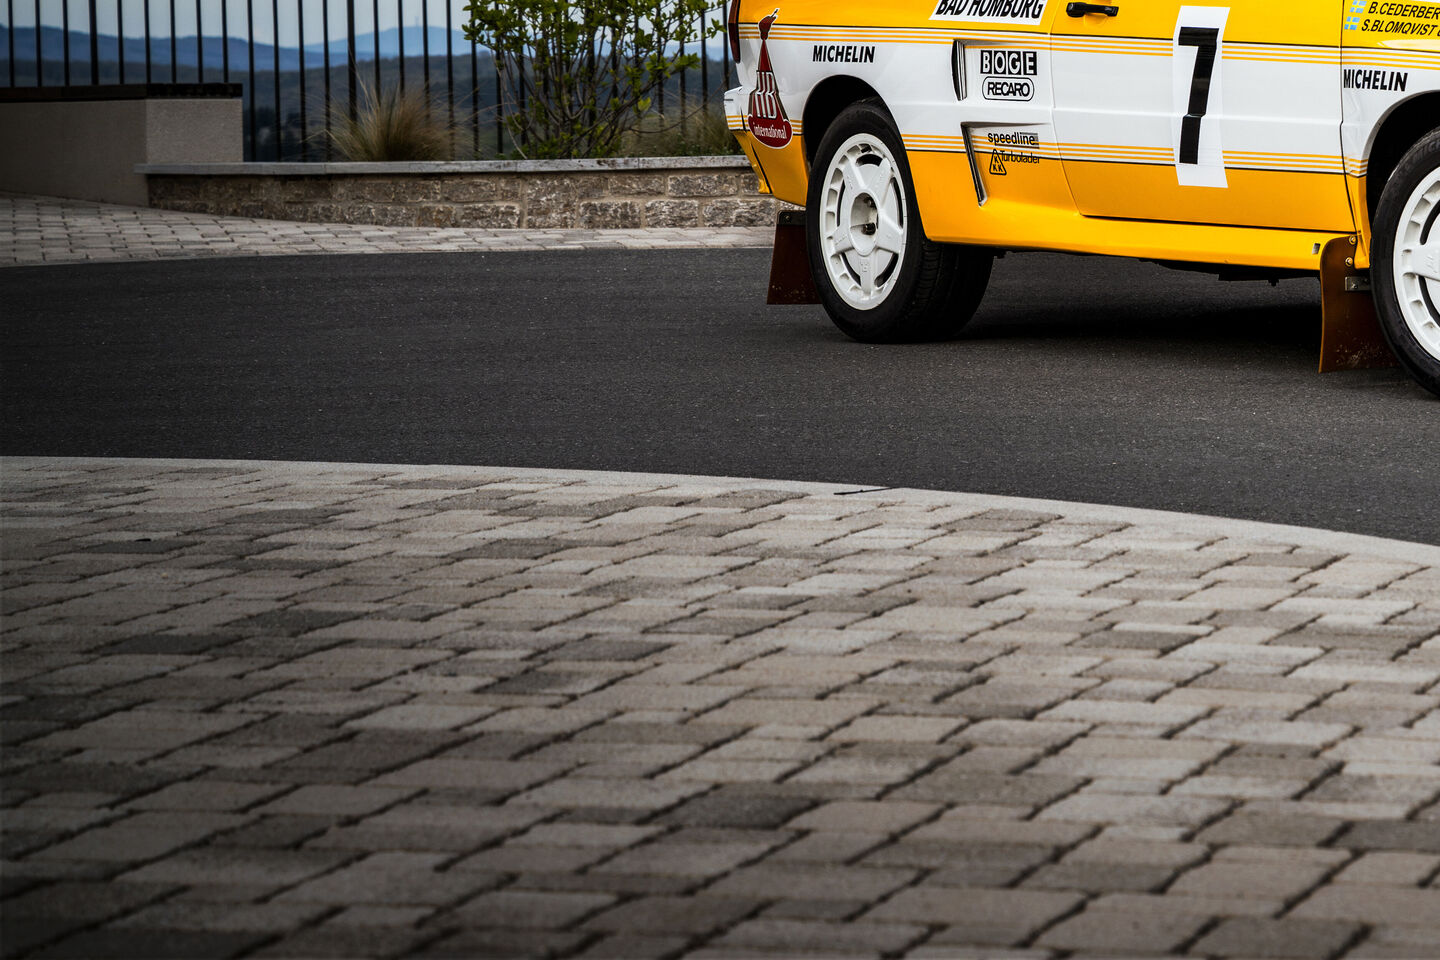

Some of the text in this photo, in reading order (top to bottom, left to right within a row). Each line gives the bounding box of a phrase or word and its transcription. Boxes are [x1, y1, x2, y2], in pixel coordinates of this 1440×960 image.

[1361, 19, 1438, 36] S.BLOMQVIST
[812, 45, 875, 63] MICHELIN
[981, 50, 1037, 75] BOGE
[1344, 68, 1408, 91] MICHELIN
[755, 71, 778, 120] HB
[987, 81, 1030, 97] RECARO
[1178, 27, 1219, 165] 7
[753, 122, 787, 140] international
[988, 131, 1036, 147] speedline
[1000, 150, 1040, 164] Turbolader
